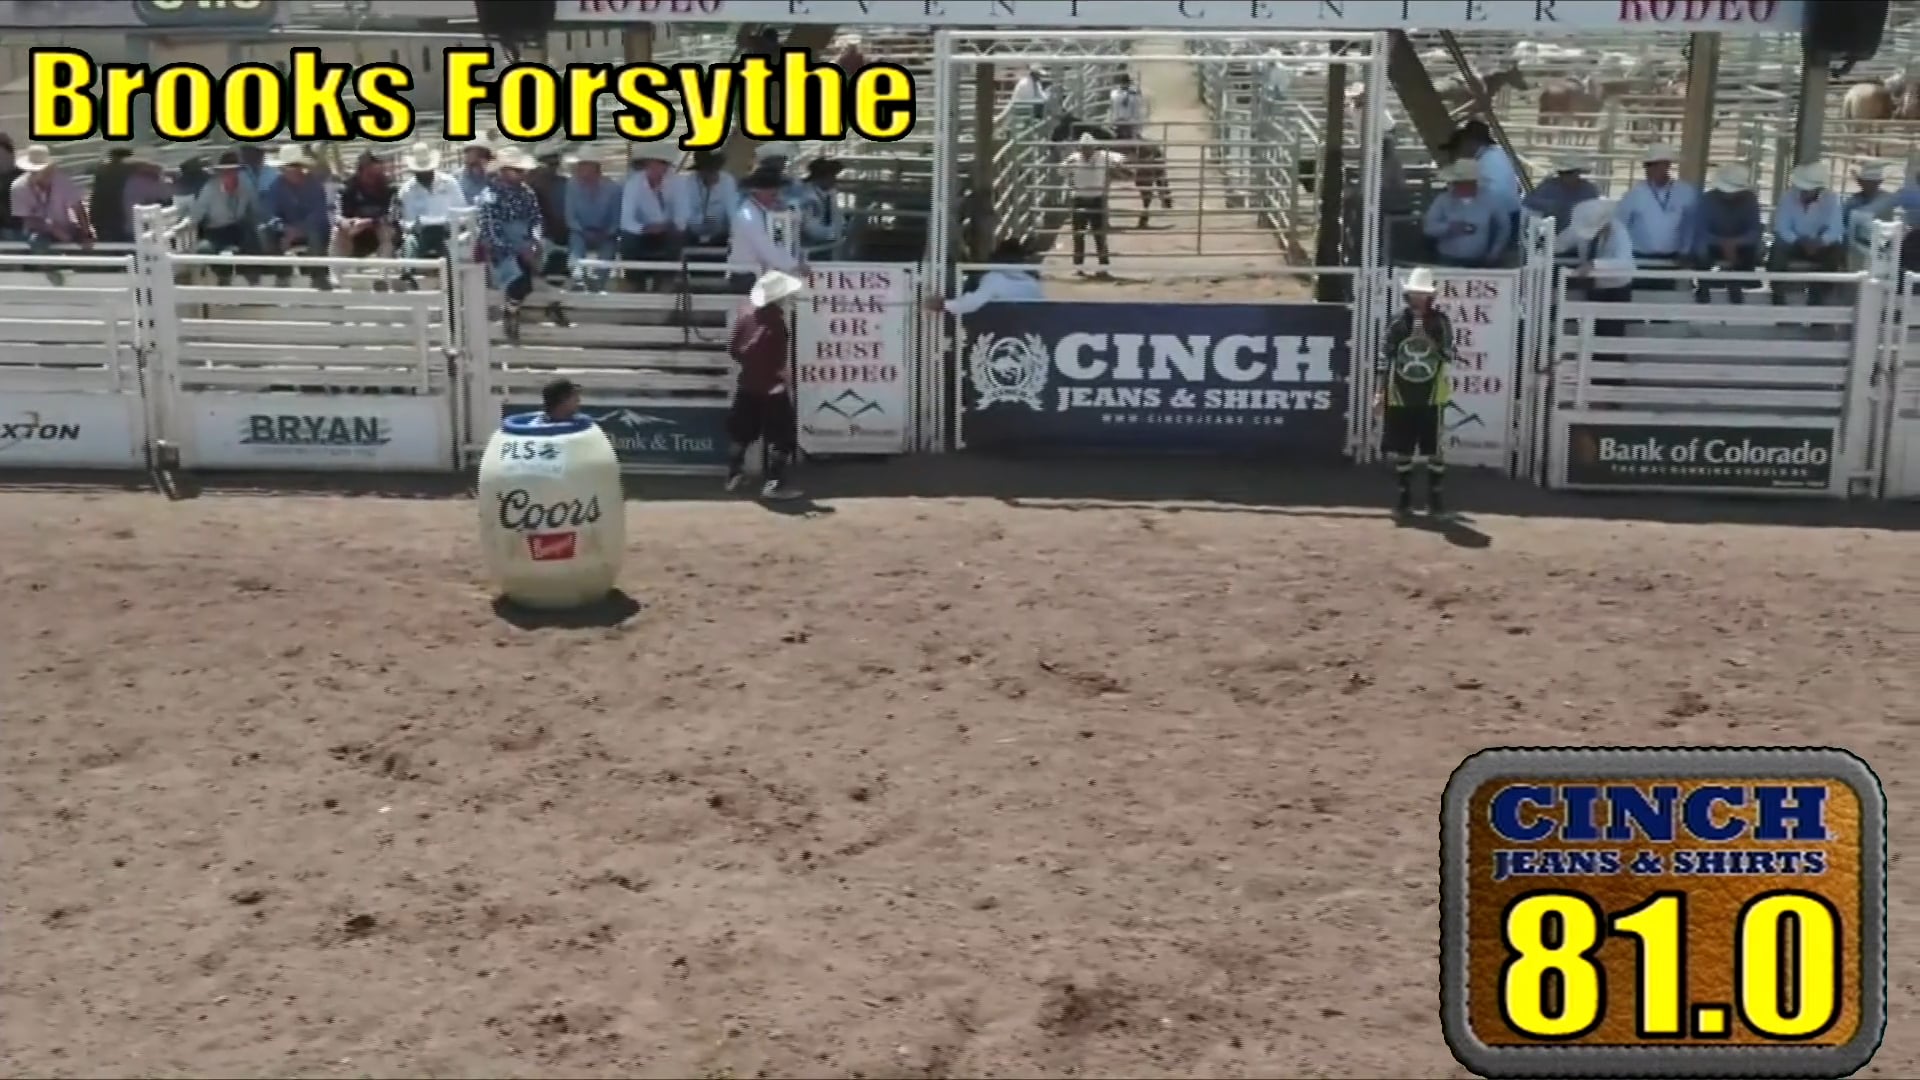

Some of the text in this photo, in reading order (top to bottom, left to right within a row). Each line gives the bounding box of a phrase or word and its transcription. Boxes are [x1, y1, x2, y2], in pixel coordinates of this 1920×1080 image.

[1618, 0, 1779, 22] RODEO
[805, 272, 891, 289] PIKES
[1433, 280, 1499, 298] KES
[811, 295, 885, 313] PEAK
[1454, 328, 1473, 346] R
[816, 341, 885, 359] BUST
[1054, 332, 1335, 382] CINCH
[801, 365, 899, 383] RODEO
[1057, 387, 1331, 412] JEANS & SHIRTS
[249, 414, 379, 442] BRYAN
[500, 440, 537, 461] PLS
[650, 434, 669, 450] &
[670, 433, 715, 451] Trust
[1600, 437, 1829, 466] Bank of Colorado
[496, 488, 603, 533] Coors
